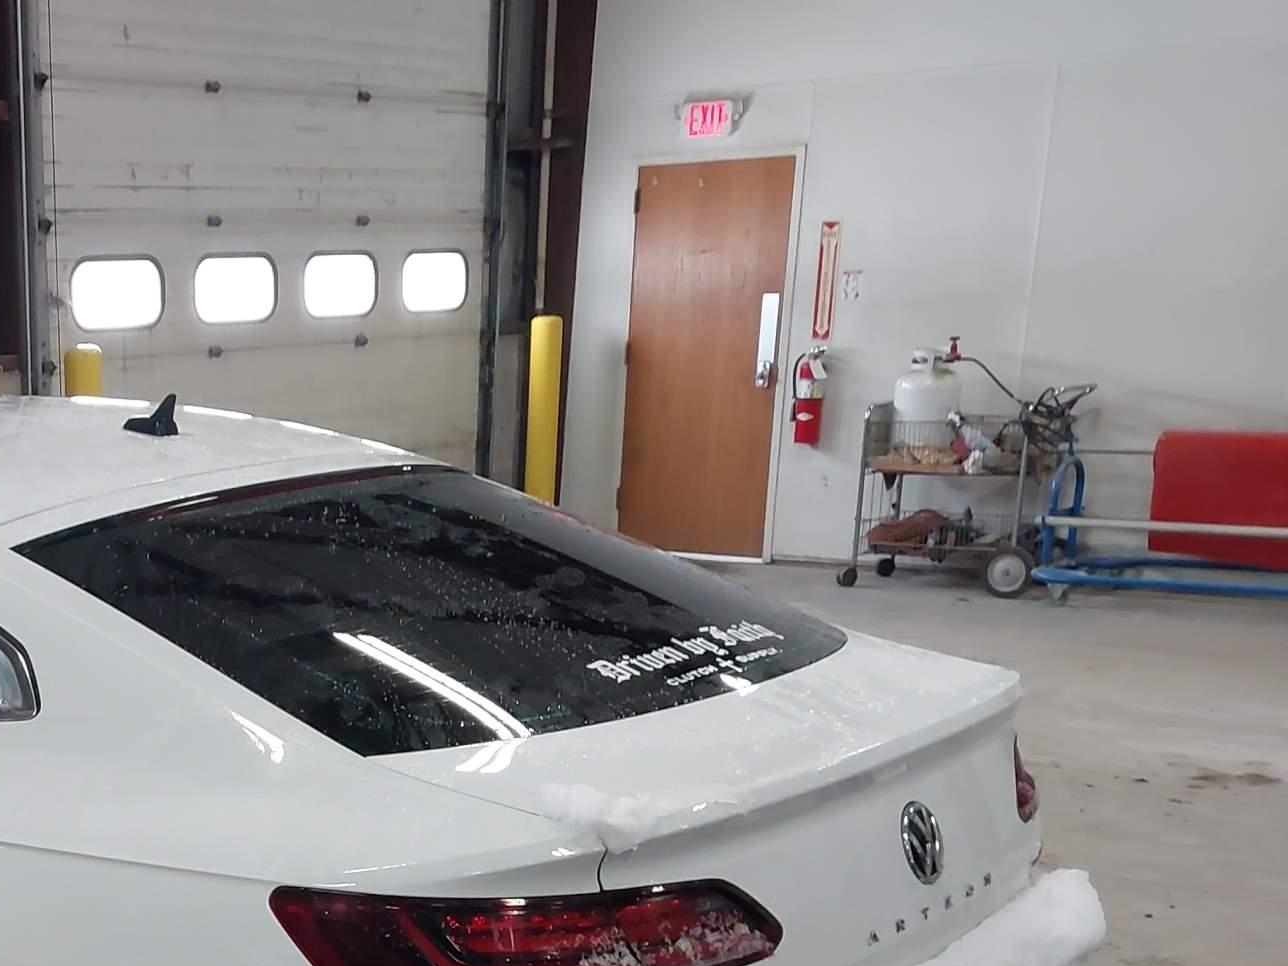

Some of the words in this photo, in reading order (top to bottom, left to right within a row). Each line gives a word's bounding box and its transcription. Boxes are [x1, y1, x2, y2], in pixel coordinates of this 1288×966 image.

[689, 102, 725, 136] EXIT
[671, 637, 729, 656] by
[699, 620, 784, 646] Faith
[586, 645, 689, 683] Driven
[666, 664, 718, 686] CLUTCH
[867, 872, 992, 946] ARTEON
